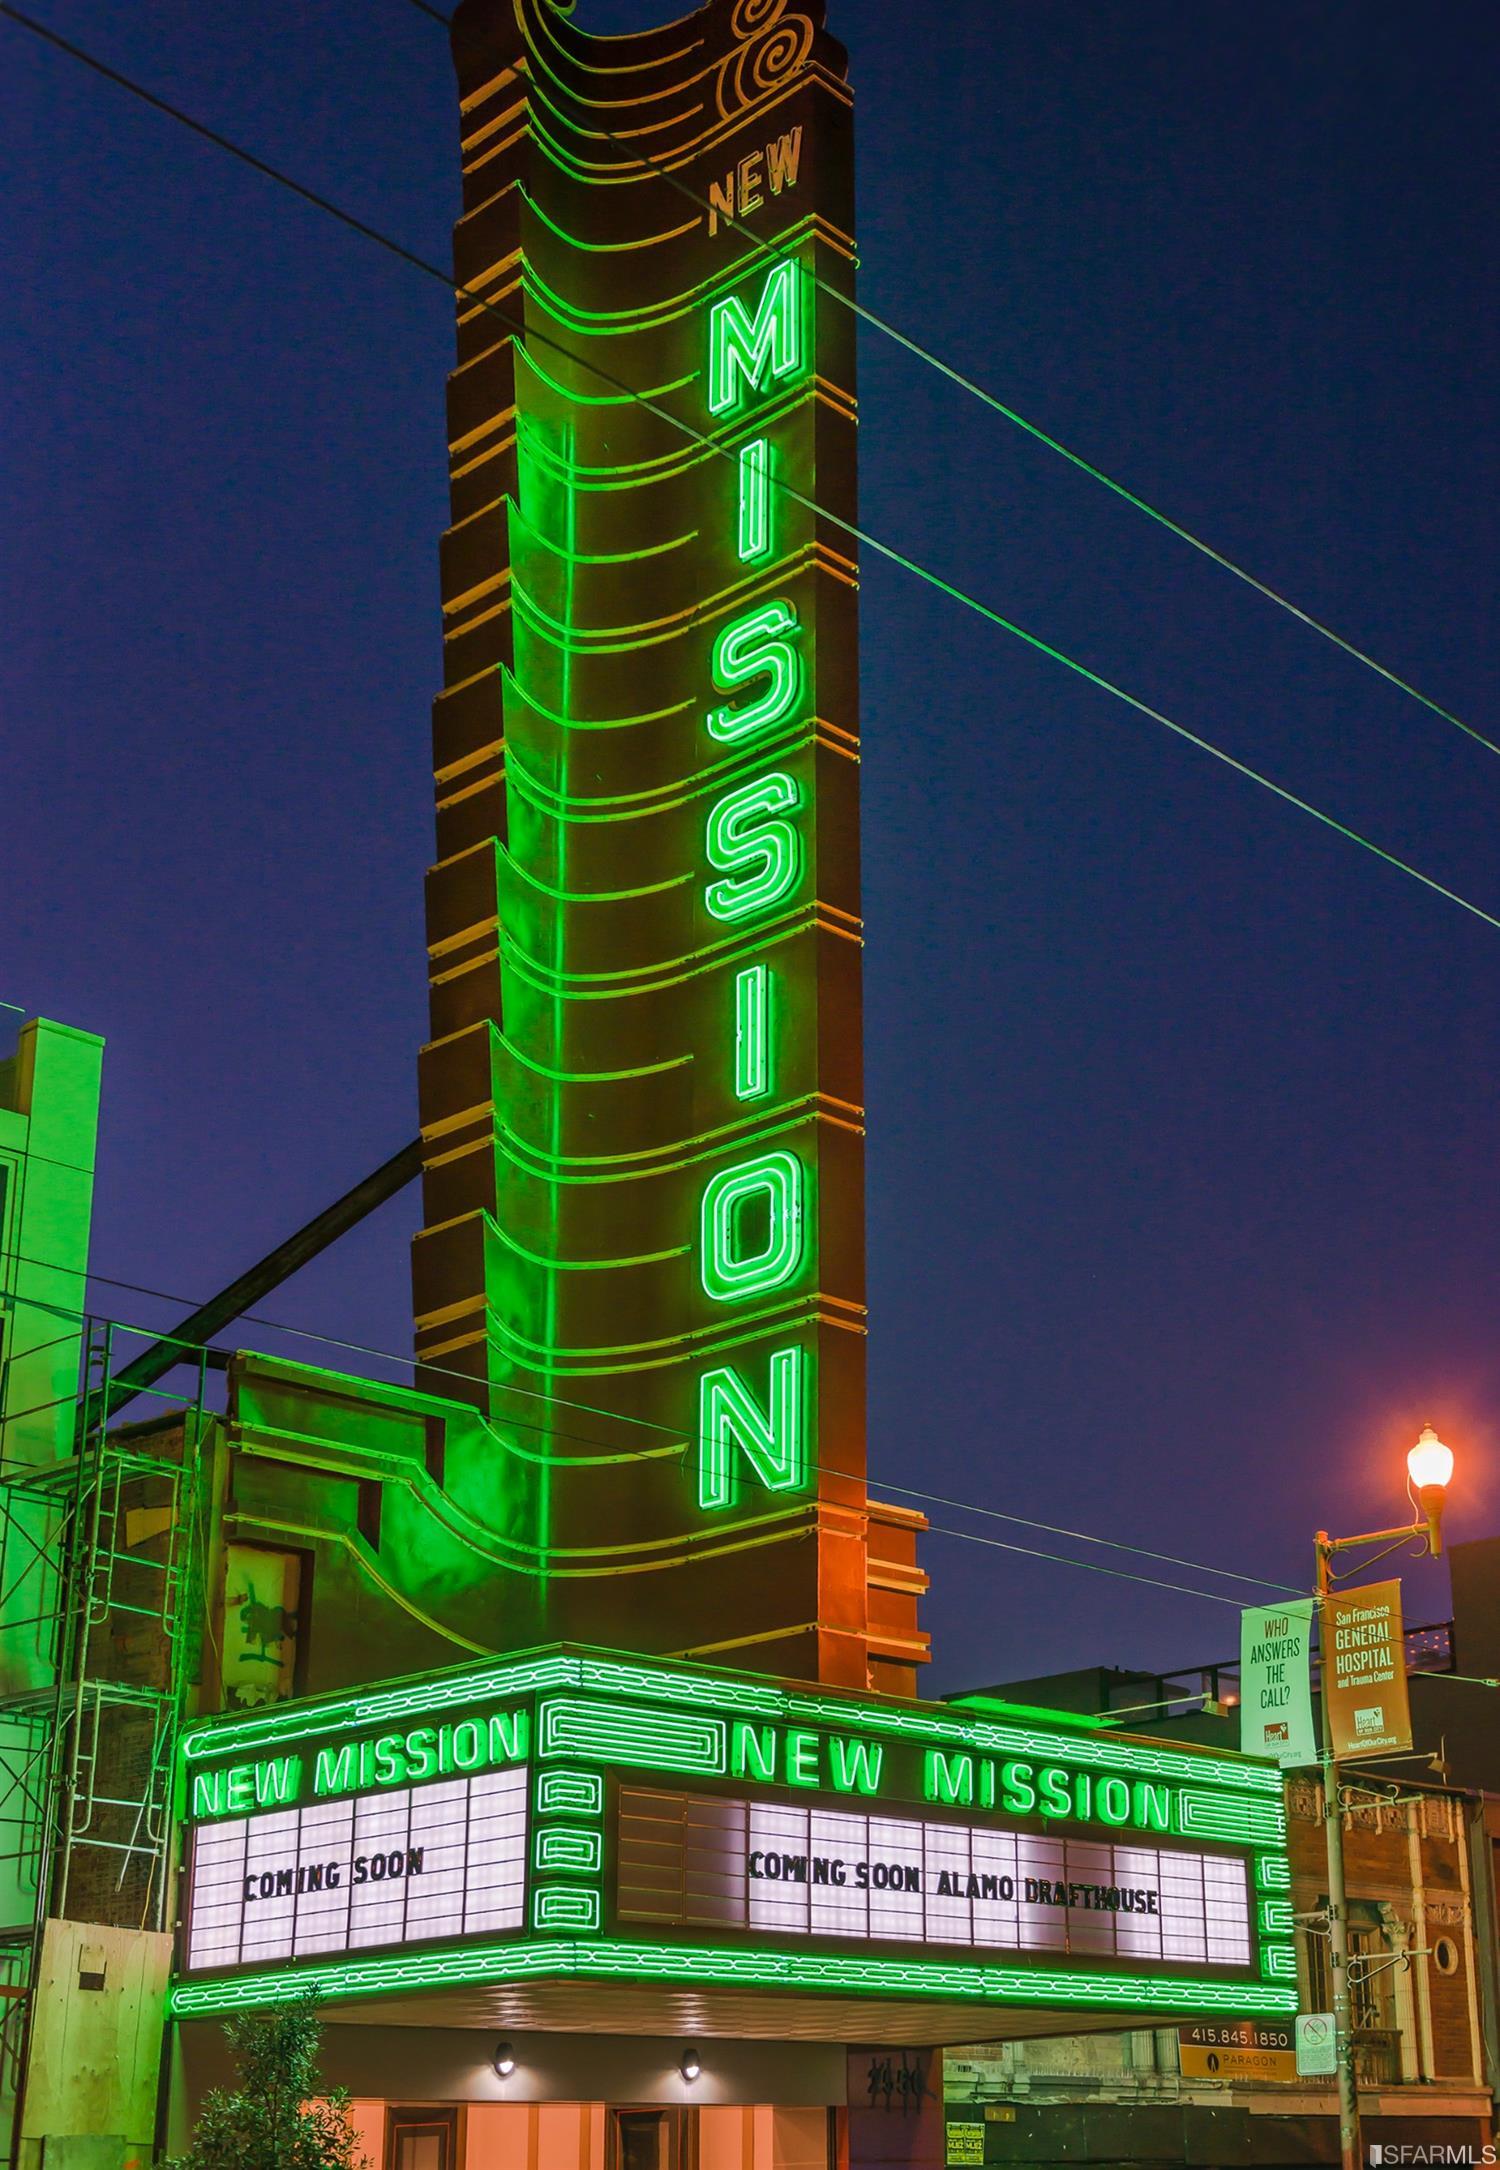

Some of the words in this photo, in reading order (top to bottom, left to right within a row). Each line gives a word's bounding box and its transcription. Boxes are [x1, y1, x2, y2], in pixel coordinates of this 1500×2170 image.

[709, 126, 802, 237] NEW
[699, 257, 804, 1510] MISSION
[1264, 1617, 1289, 1638] WHO
[1336, 1611, 1351, 1626] San
[1352, 1605, 1390, 1623] Francisco
[1335, 1621, 1393, 1650] GENERAL
[1250, 1637, 1300, 1664] ANSWERS
[1336, 1647, 1394, 1675] HOSPITAL
[1266, 1664, 1285, 1685] THE
[1337, 1676, 1349, 1689] and
[1350, 1674, 1373, 1687] Trauma
[1373, 1670, 1394, 1683] Center
[1260, 1685, 1291, 1709] CALL?
[1357, 1715, 1376, 1729] Heart
[1265, 1729, 1283, 1743] Heart
[193, 1755, 301, 1818] NEW
[314, 1709, 531, 1797] MISSION
[731, 1721, 883, 1796] NEW
[924, 1749, 1170, 1832] MISSION
[243, 1862, 340, 1902] COMING
[353, 1847, 425, 1884] SOON
[749, 1851, 847, 1886] COMING
[858, 1862, 920, 1893] SOON
[937, 1870, 1014, 1901] ALAMO
[1024, 1877, 1159, 1916] DRAFTHOUSE
[1192, 2028, 1288, 2047] 415.845.1850
[1223, 2054, 1277, 2067] PARAGON
